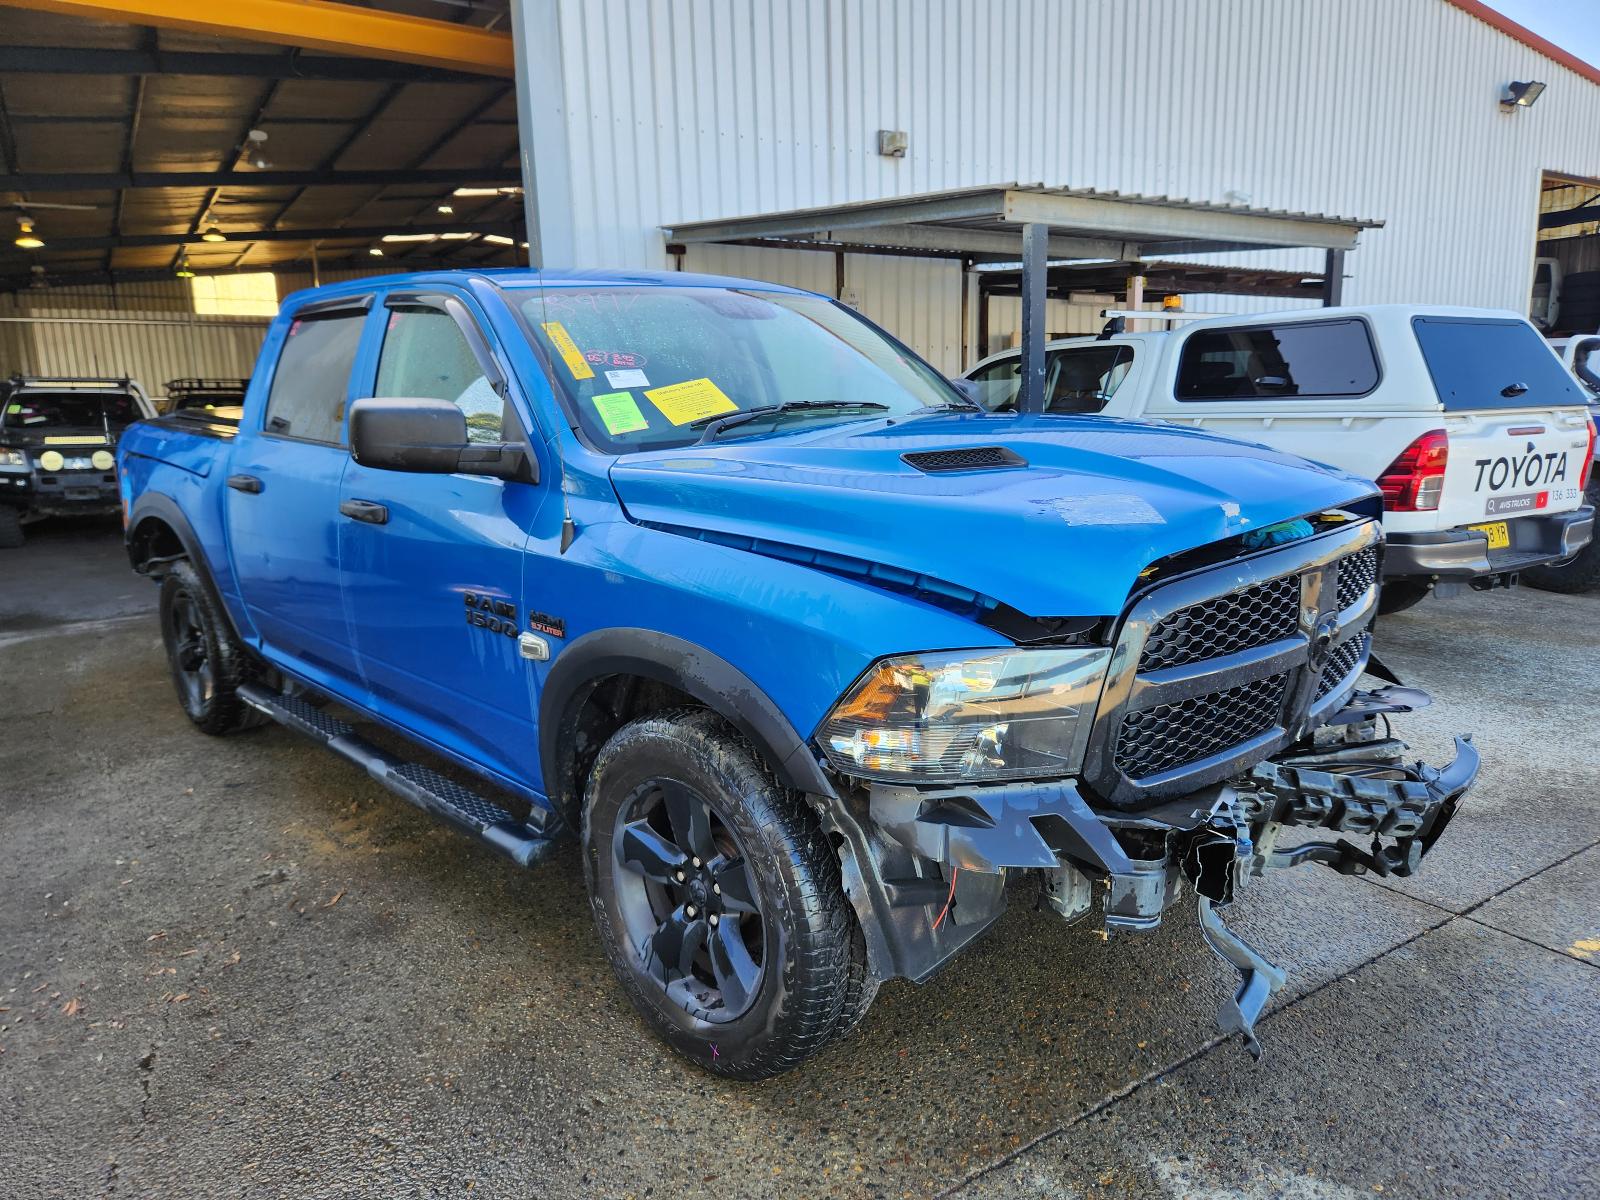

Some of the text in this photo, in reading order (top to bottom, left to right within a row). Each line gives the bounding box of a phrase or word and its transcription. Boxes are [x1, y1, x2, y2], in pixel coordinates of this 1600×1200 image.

[1474, 451, 1567, 493] TOYOTA
[1552, 488, 1577, 501] 136 333
[464, 591, 516, 620] RAM
[465, 608, 519, 640] 1500
